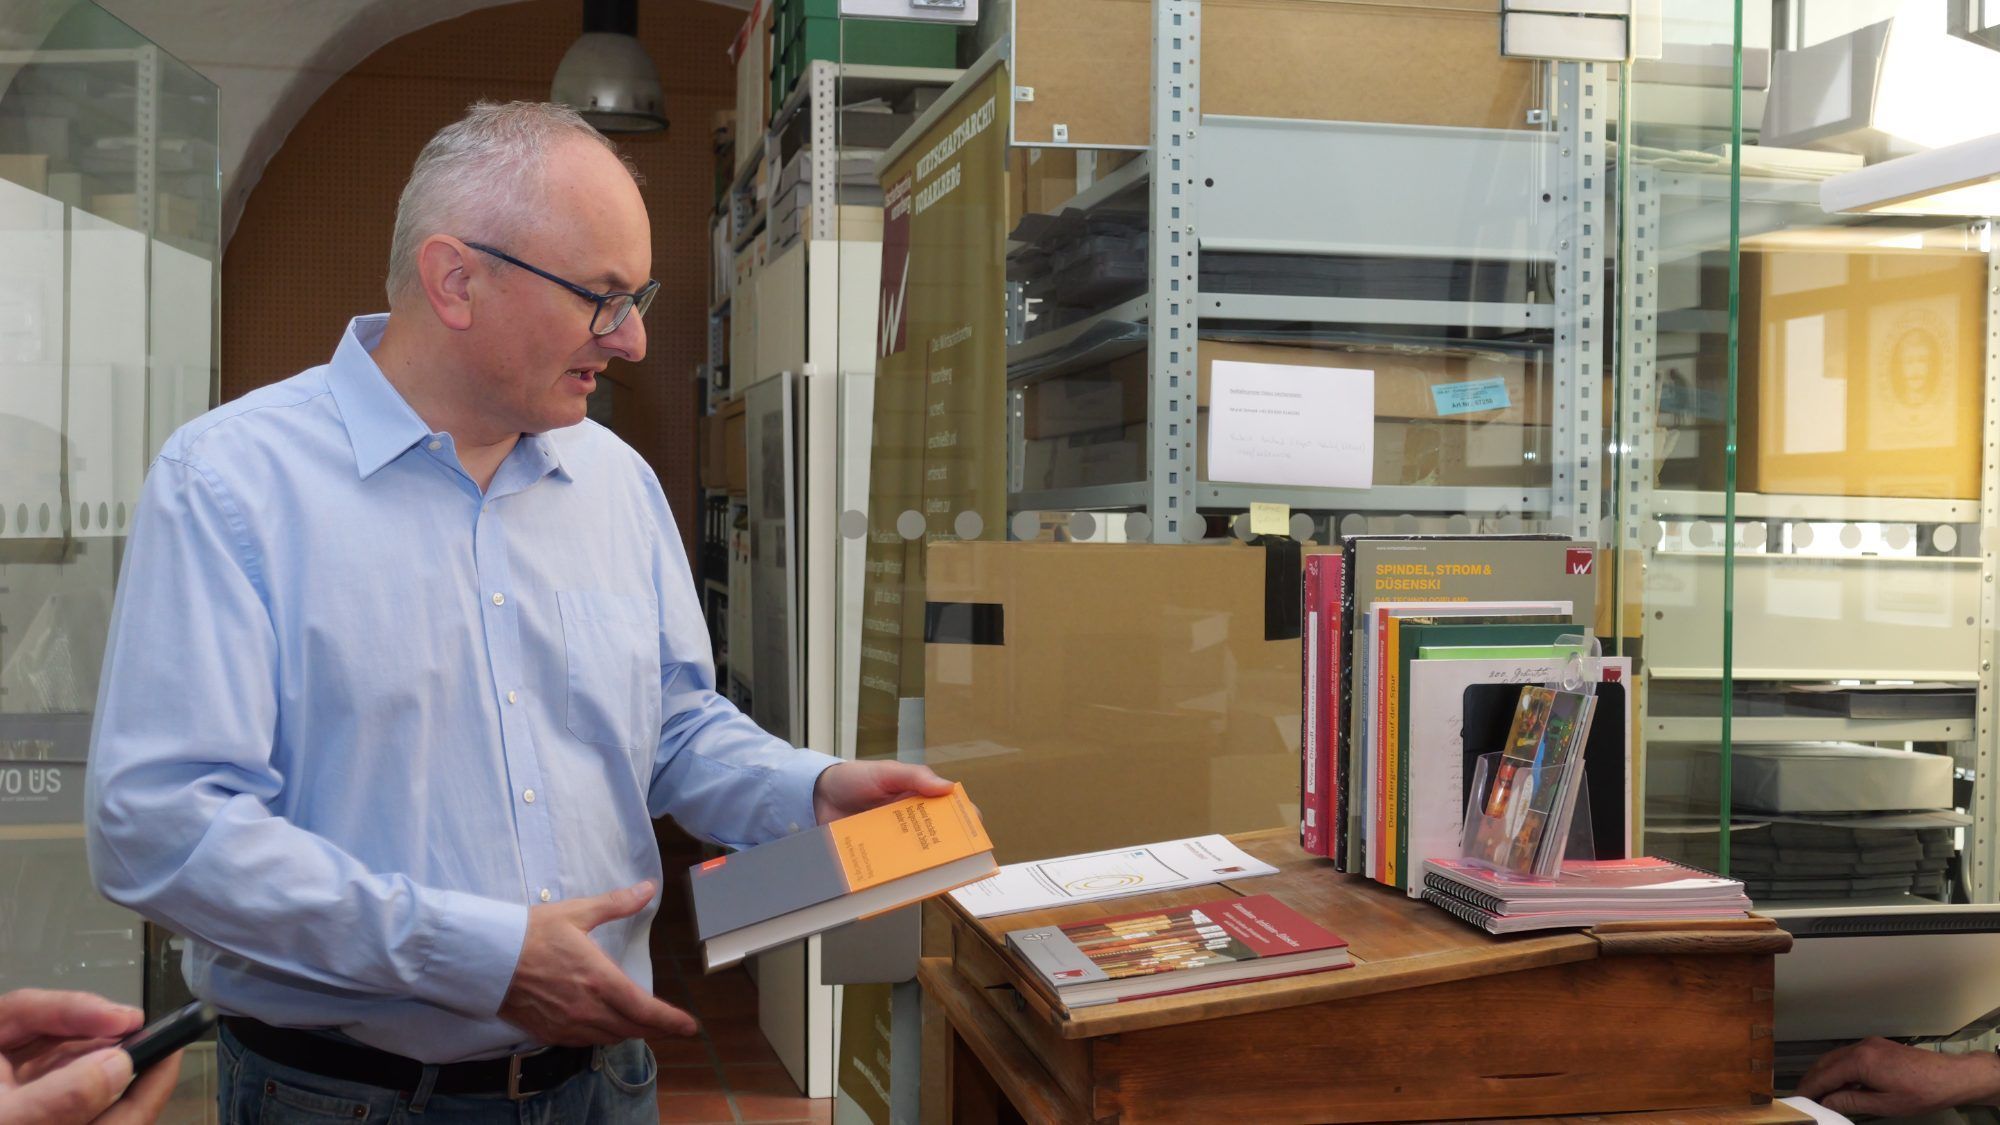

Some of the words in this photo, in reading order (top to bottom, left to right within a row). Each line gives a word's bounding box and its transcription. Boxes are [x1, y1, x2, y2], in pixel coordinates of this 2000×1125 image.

[916, 95, 995, 183] WIRTSCHAFTSARCHIV
[915, 162, 960, 216] VORARLBERG
[1375, 577, 1440, 590] DÜSENSKI
[1376, 564, 1434, 577] SPINDEL,
[1436, 564, 1482, 576] STROM
[1483, 564, 1493, 576] &
[29, 768, 61, 794] ÜS
